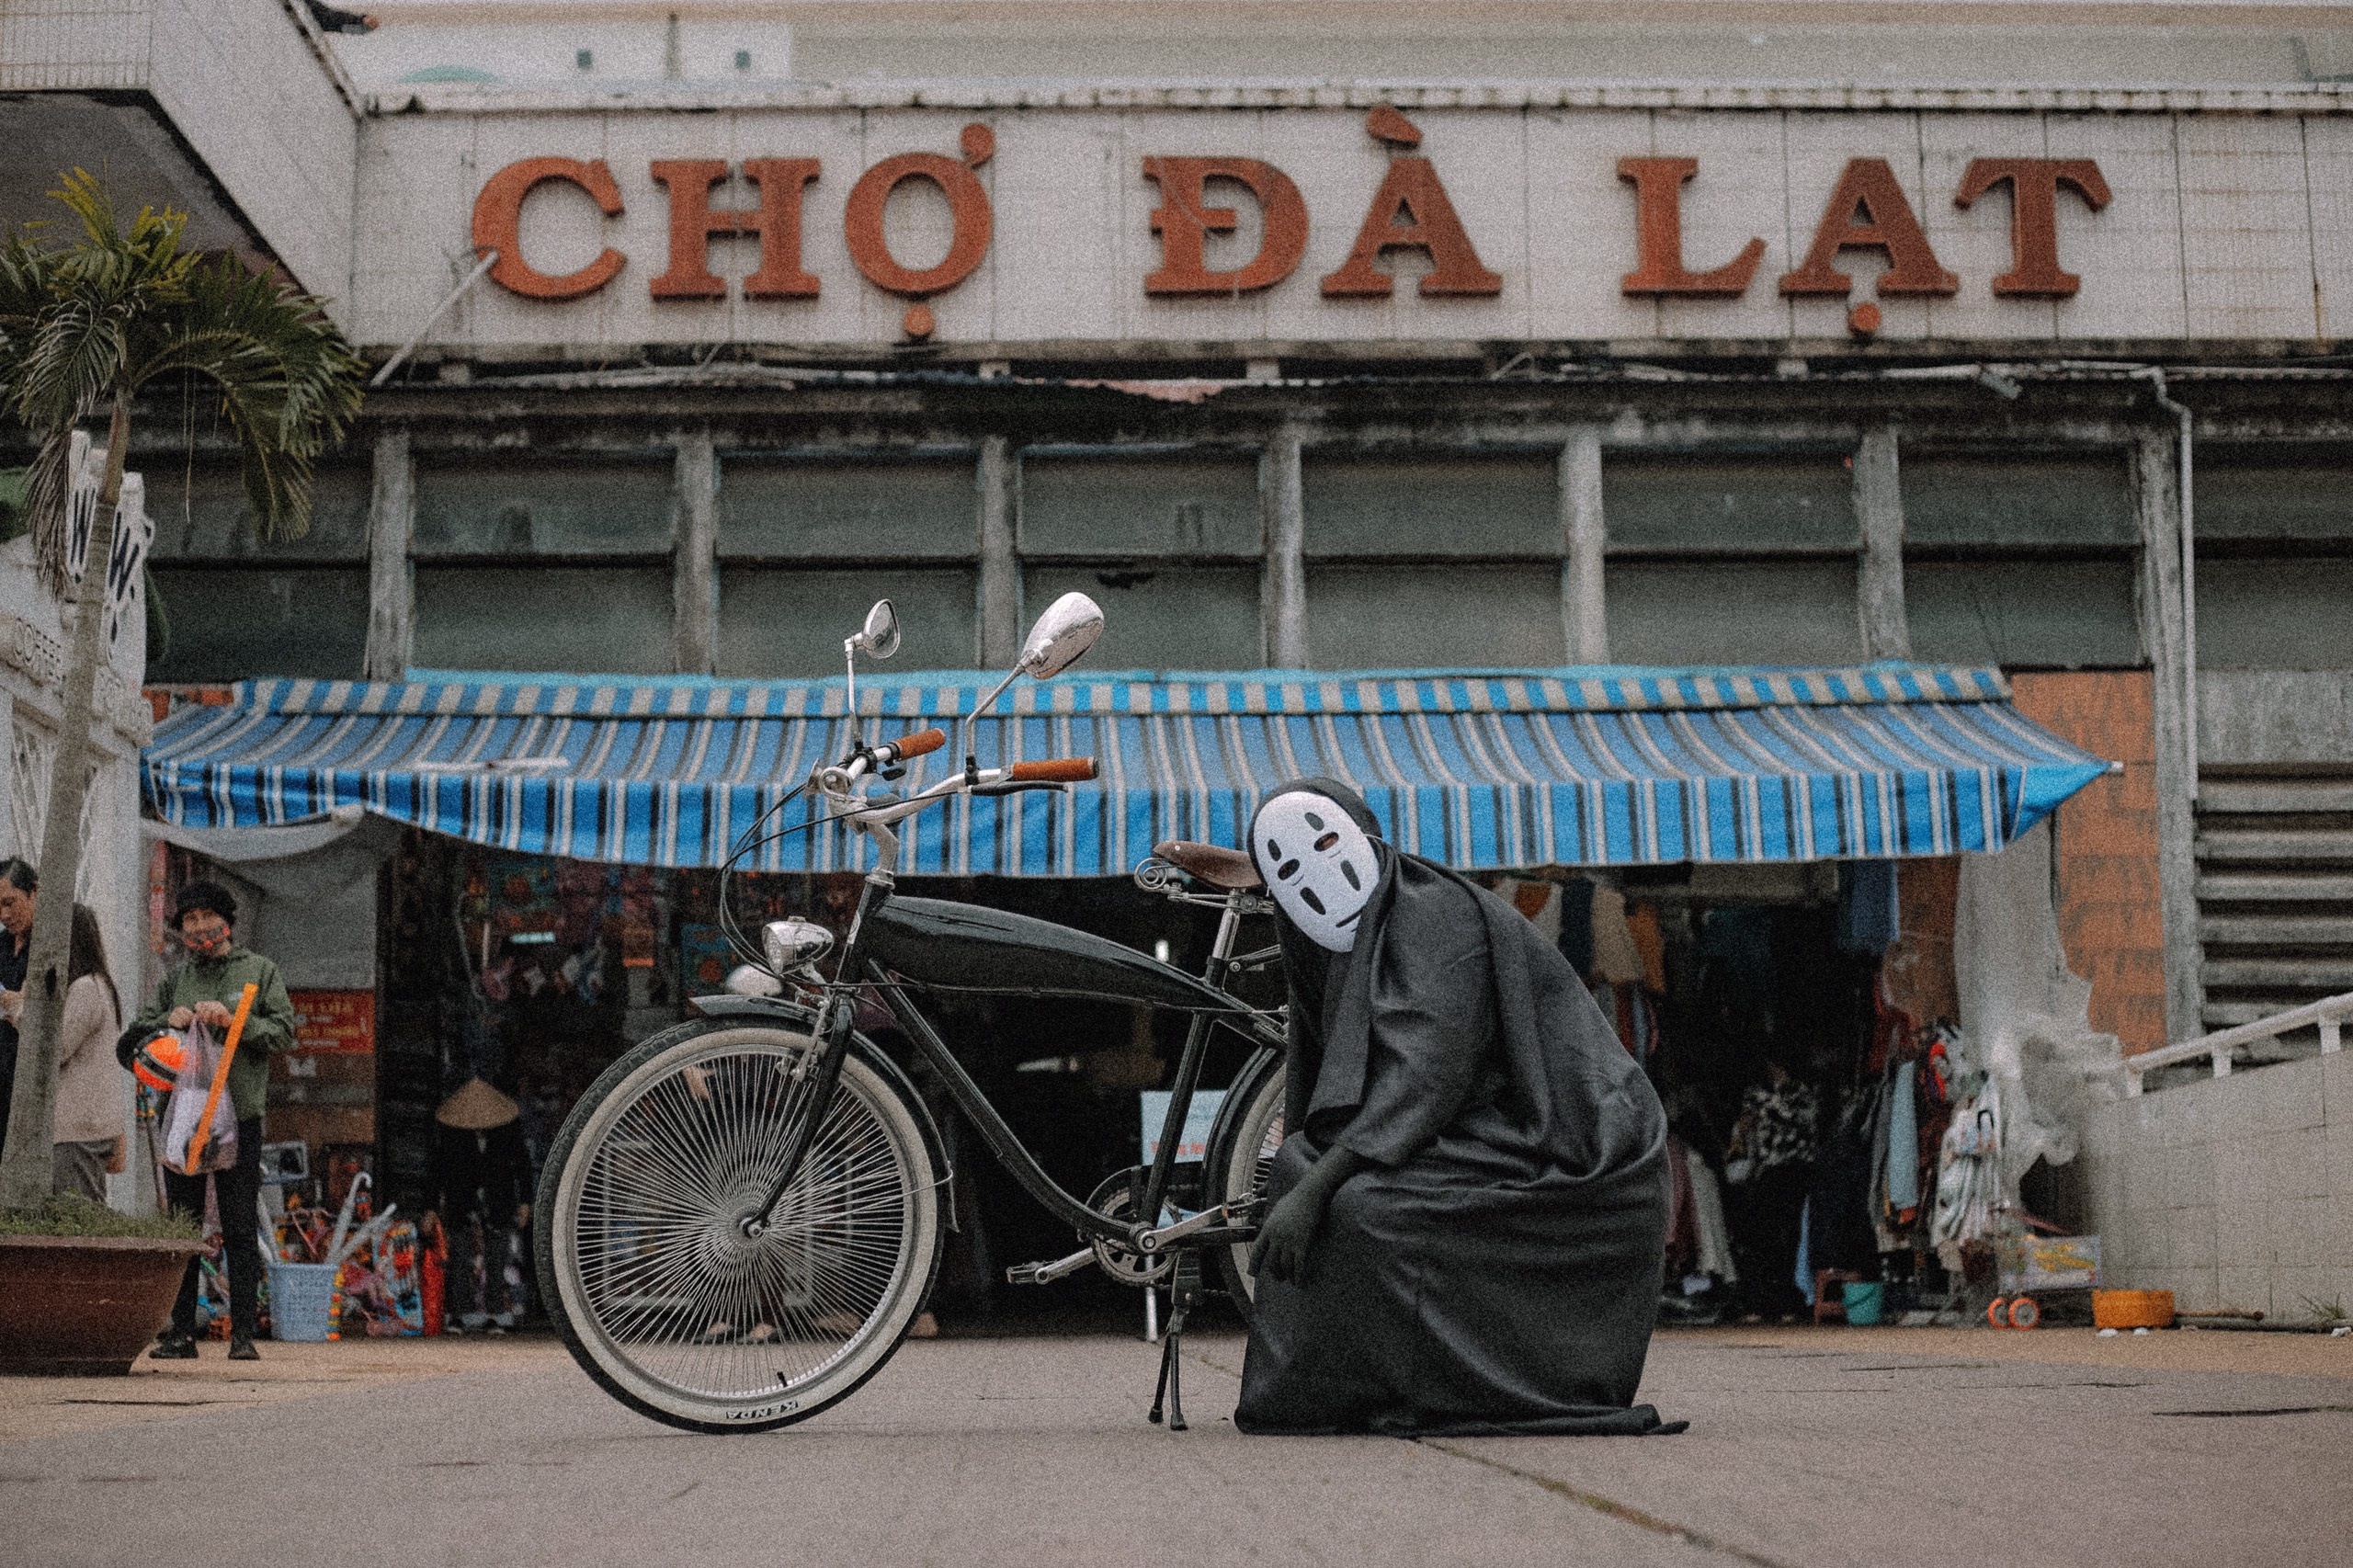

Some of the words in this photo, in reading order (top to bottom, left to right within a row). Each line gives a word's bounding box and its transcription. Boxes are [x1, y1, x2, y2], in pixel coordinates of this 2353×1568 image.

[472, 123, 995, 337] CHỢ
[1142, 106, 1503, 297] ĐÀ
[1616, 156, 2113, 335] LẠT
[725, 1400, 799, 1419] KENDA
